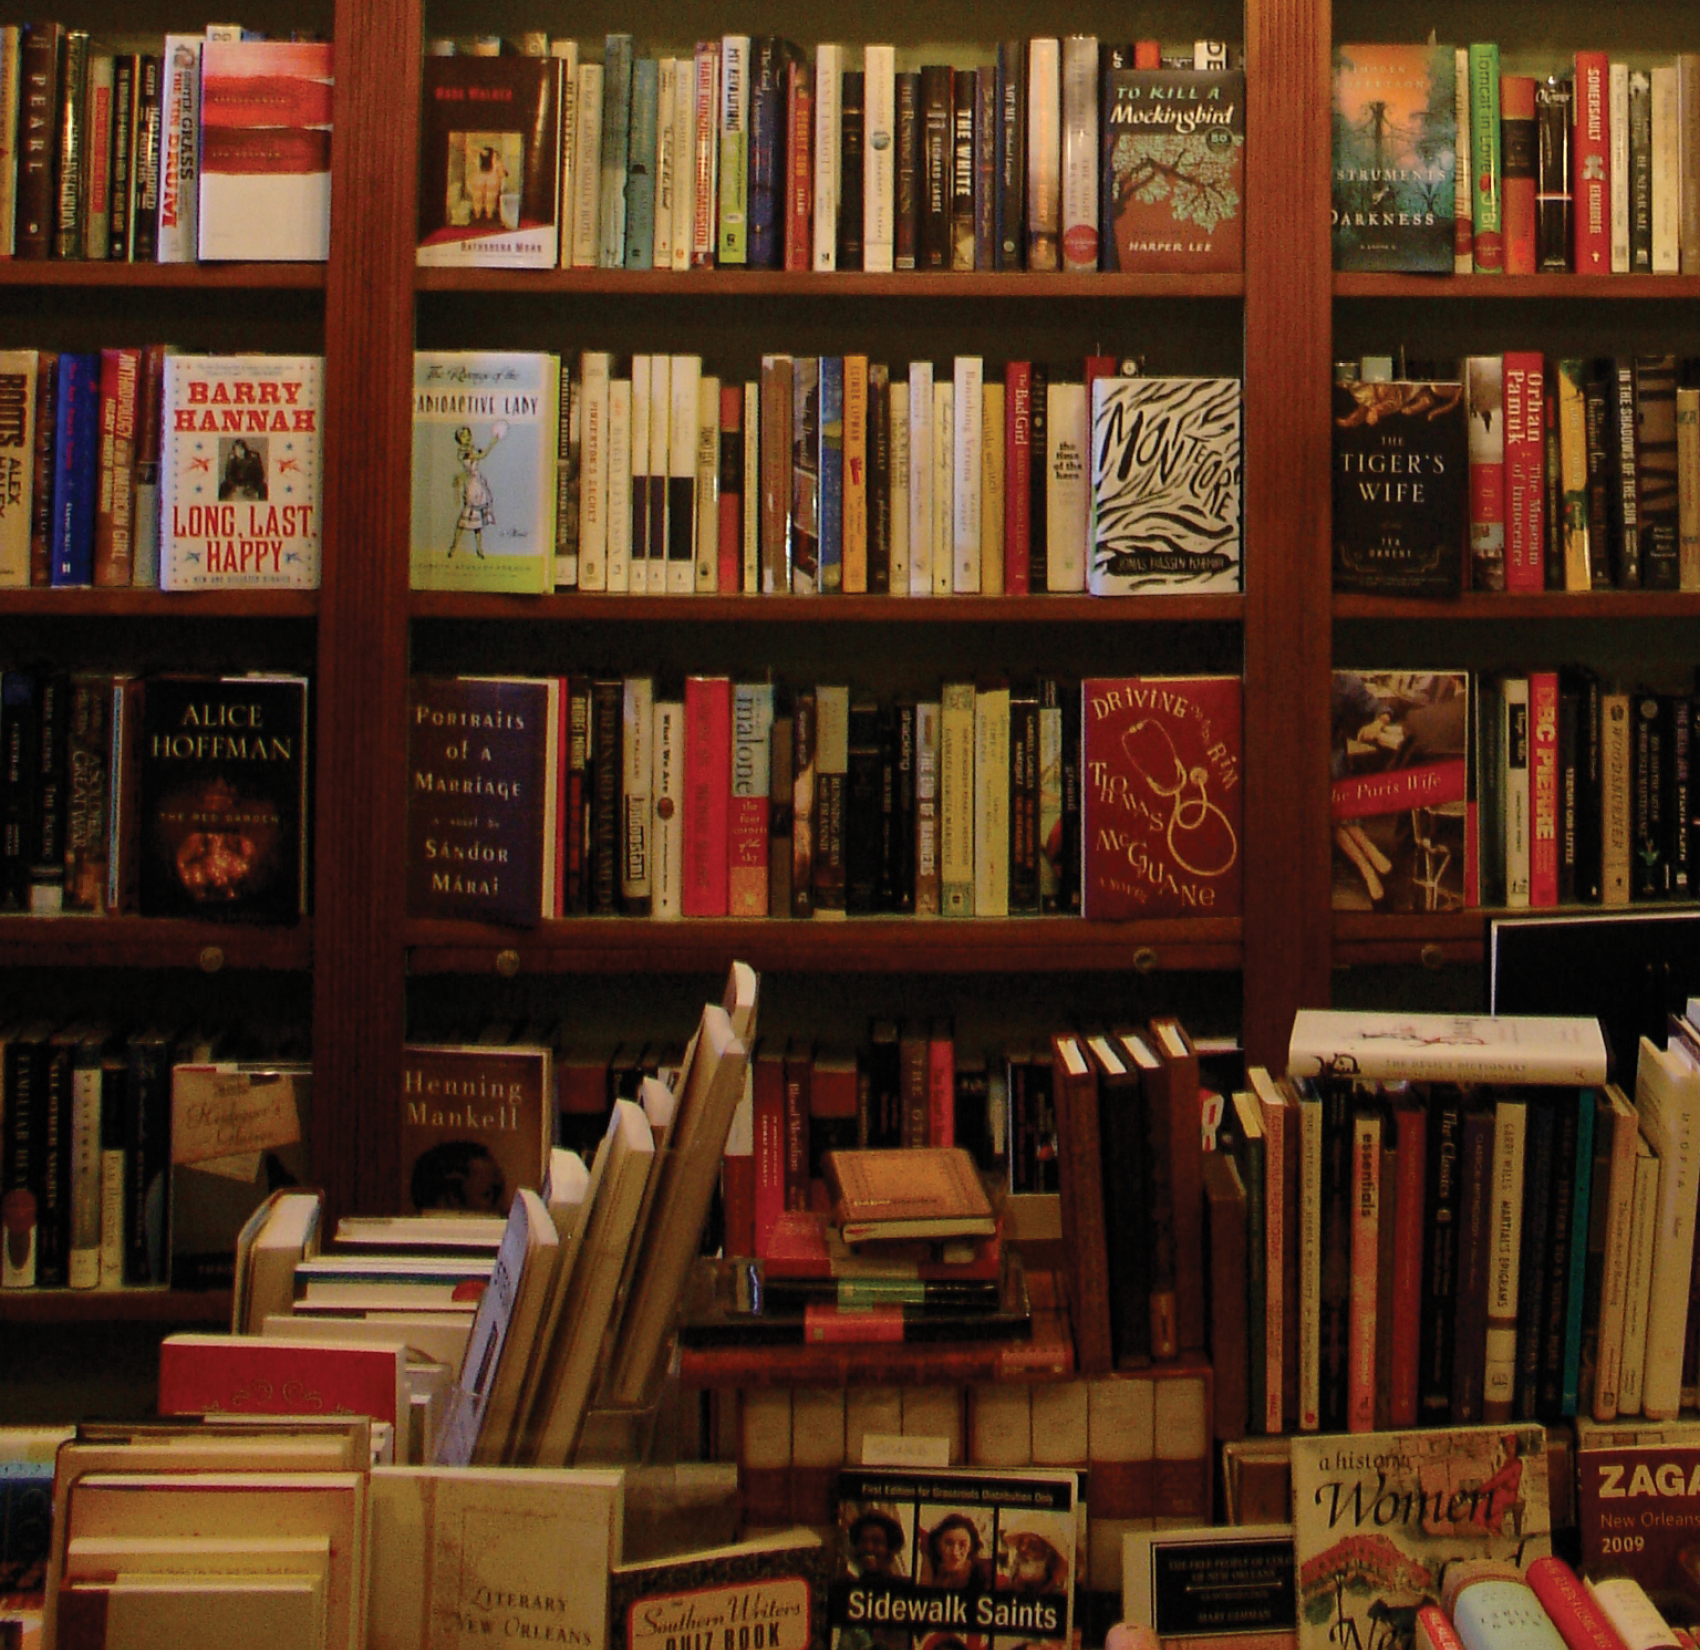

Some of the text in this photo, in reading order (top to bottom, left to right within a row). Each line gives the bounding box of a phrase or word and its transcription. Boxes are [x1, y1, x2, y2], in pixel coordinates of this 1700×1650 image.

[1117, 86, 1220, 100] TO KILL A
[1587, 68, 1601, 141] SOMERSAULT
[27, 73, 47, 174] PEARL
[1110, 102, 1234, 134] Mockingbird
[1475, 52, 1493, 171] Tomcat in Love
[179, 116, 194, 180] GRASS
[955, 108, 973, 197] THE WHITE
[1636, 156, 1647, 232] BE NEAR ME
[1331, 211, 1436, 228] DARKNESS
[1128, 240, 1213, 253] HARPER LEE
[188, 382, 302, 405] BARRY
[1013, 389, 1029, 415] Bad
[1507, 369, 1525, 446] Pamuk
[1526, 372, 1543, 443] Orhan
[174, 409, 316, 433] HANNAH
[1013, 416, 1029, 445] Girl
[112, 354, 137, 559] ANTHROPOLOGY AMERICAN GIRL
[1381, 436, 1404, 447] THE
[1618, 369, 1637, 525] IN THE SHADOWS OF THE SUN
[8, 458, 22, 506] ALEX
[1341, 454, 1446, 475] TIGER'S
[1359, 483, 1425, 503] WIFE
[173, 504, 317, 539] LONG, LAST,
[1511, 463, 1525, 567] of Innocence
[1528, 463, 1541, 566] The Museum
[206, 540, 284, 573] HAPPY
[180, 704, 264, 728] ALICE
[151, 734, 292, 761] HOFFMAN
[661, 714, 671, 794] What We Are
[734, 697, 763, 797] malone
[1565, 767, 1575, 806] VERNON
[919, 751, 935, 877] THE END OF MANNERS
[1565, 832, 1574, 865] LITTLE
[403, 1071, 523, 1104] Henning
[406, 1103, 518, 1131] Mankell
[1439, 1111, 1457, 1198] The Classics
[1360, 1133, 1374, 1217] essentials
[1315, 1480, 1499, 1529] Women
[1601, 1512, 1635, 1529] New
[1602, 1536, 1645, 1553] 2009
[642, 1593, 801, 1638] Southern Writers
[847, 1592, 1059, 1630] Sidewalk Saints
[504, 1616, 593, 1646] ORLEANS
[724, 1623, 781, 1650] BOOK
